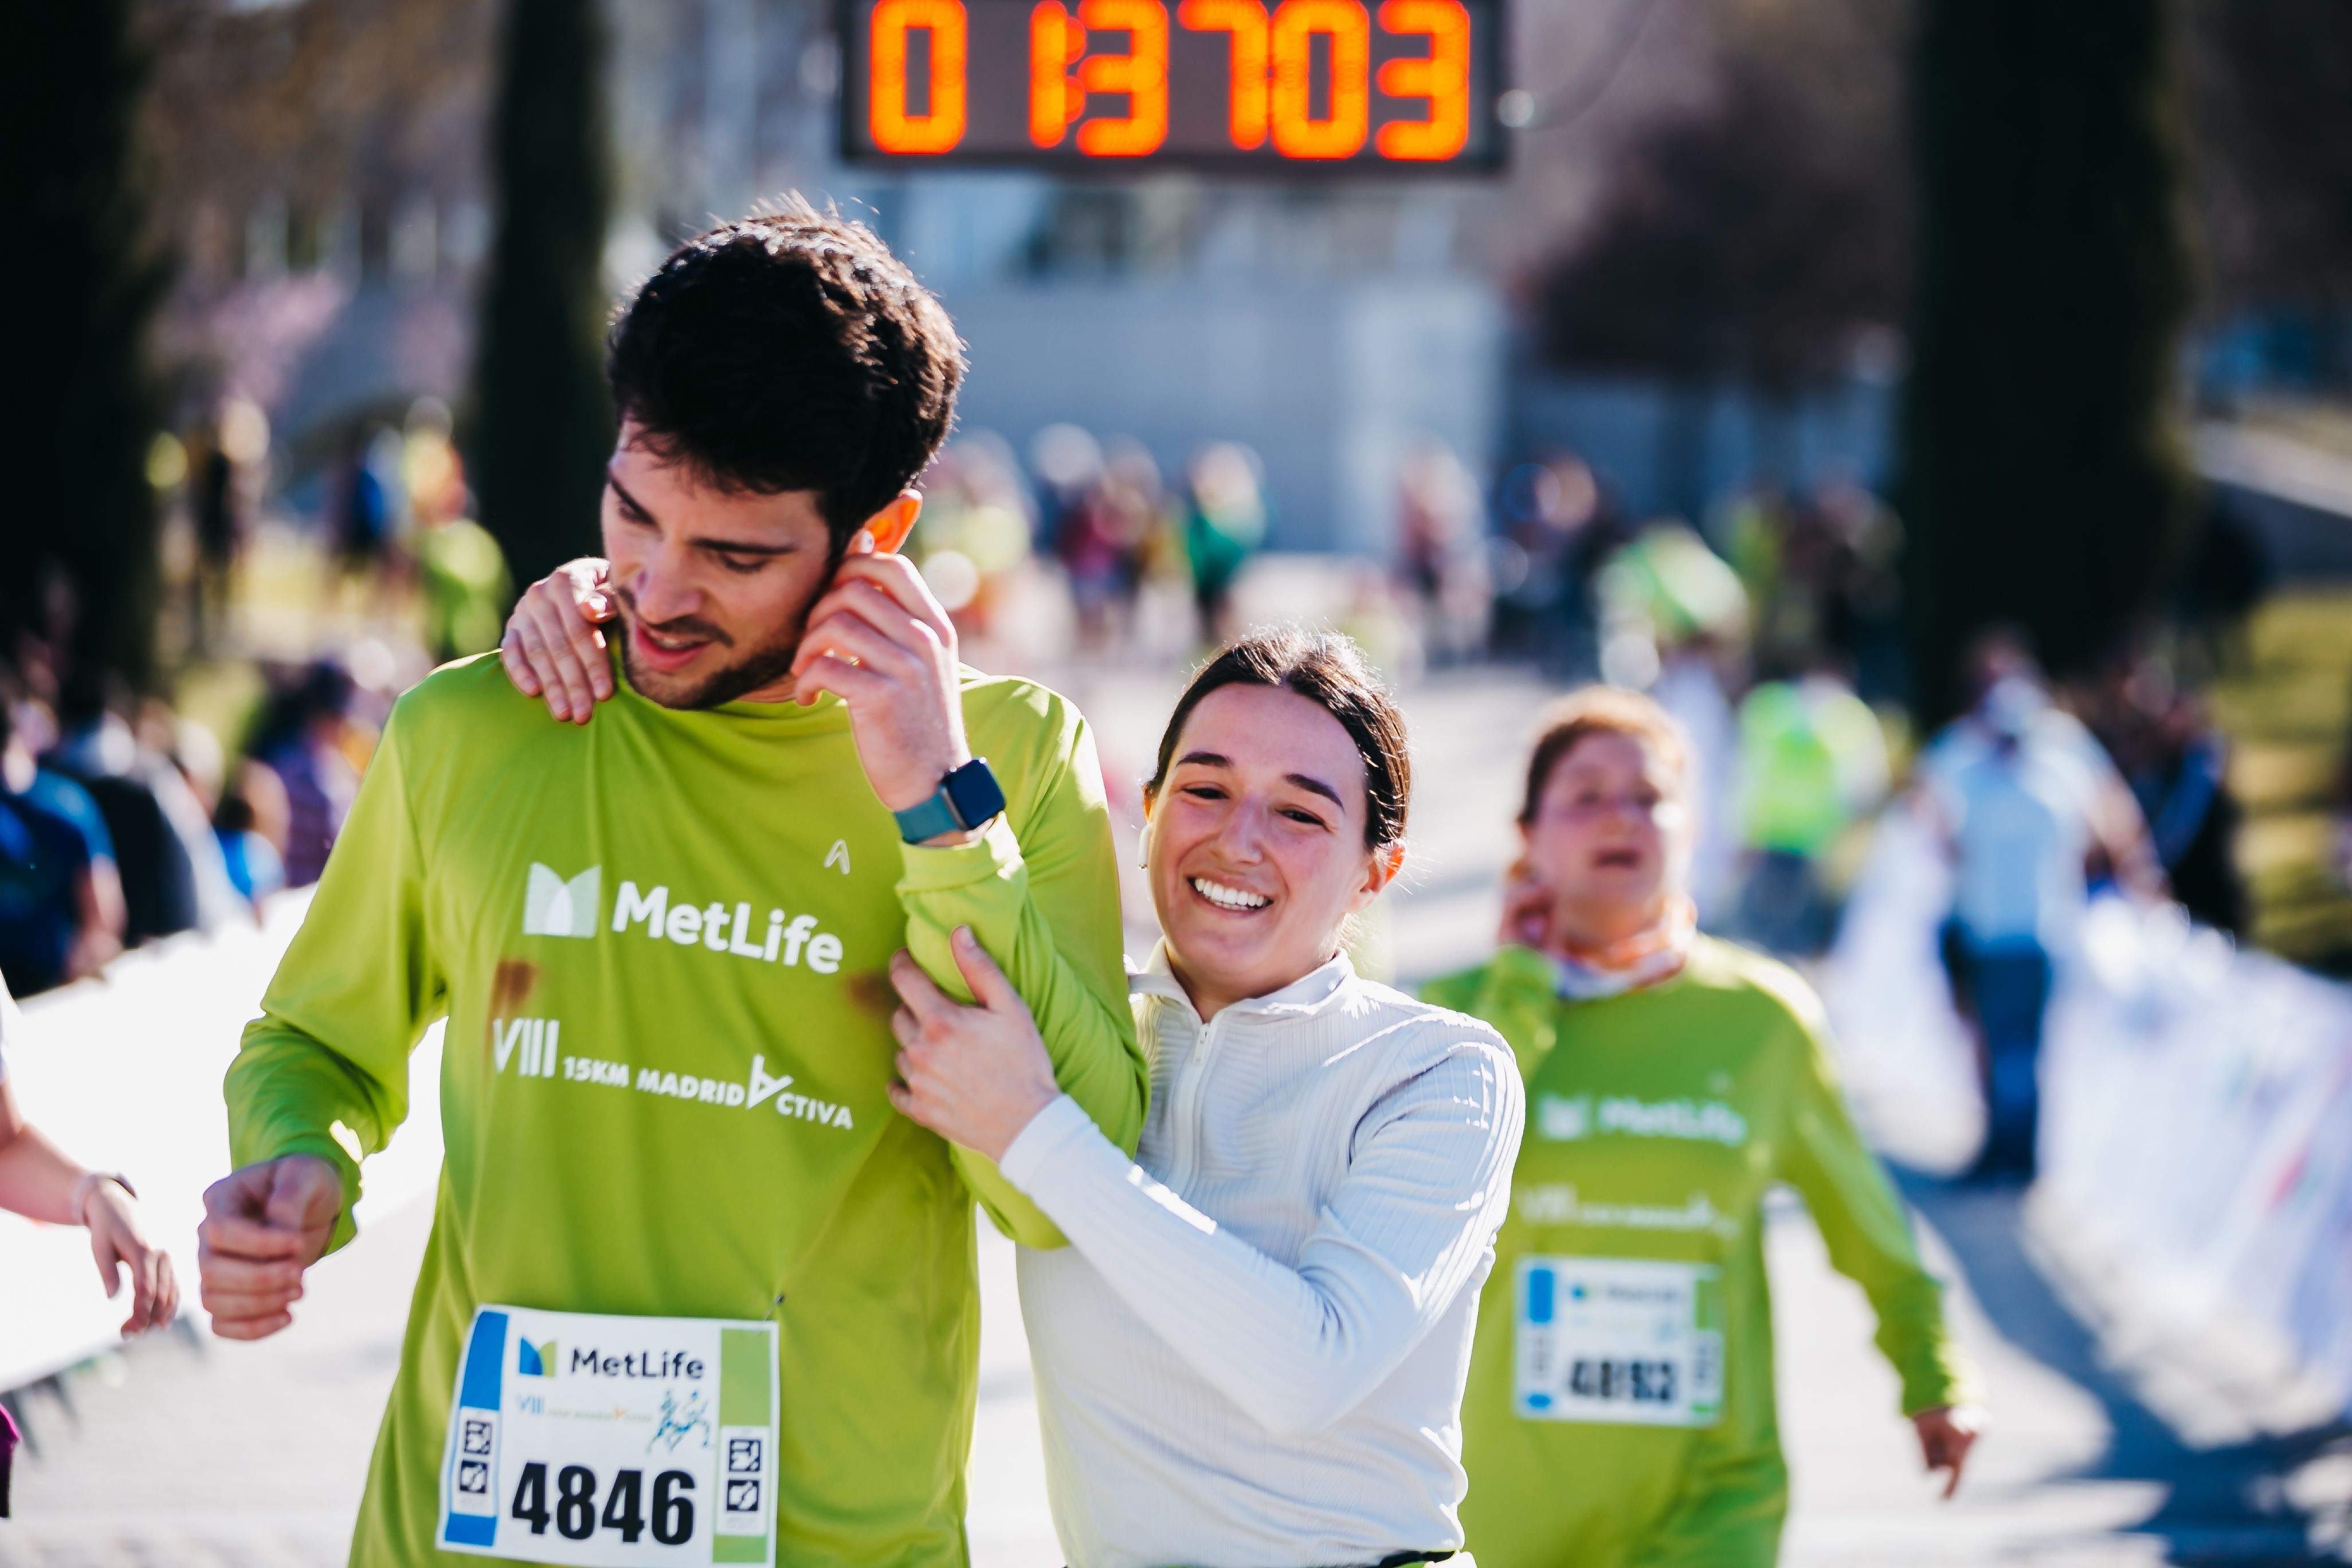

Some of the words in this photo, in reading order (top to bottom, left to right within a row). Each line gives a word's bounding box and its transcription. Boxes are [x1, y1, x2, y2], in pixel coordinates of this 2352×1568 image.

[611, 880, 843, 974] MetLife
[492, 1017, 560, 1078] VIII
[563, 1056, 630, 1088] 15KM
[572, 1348, 704, 1379] MetLife
[512, 1461, 697, 1547] 4846
